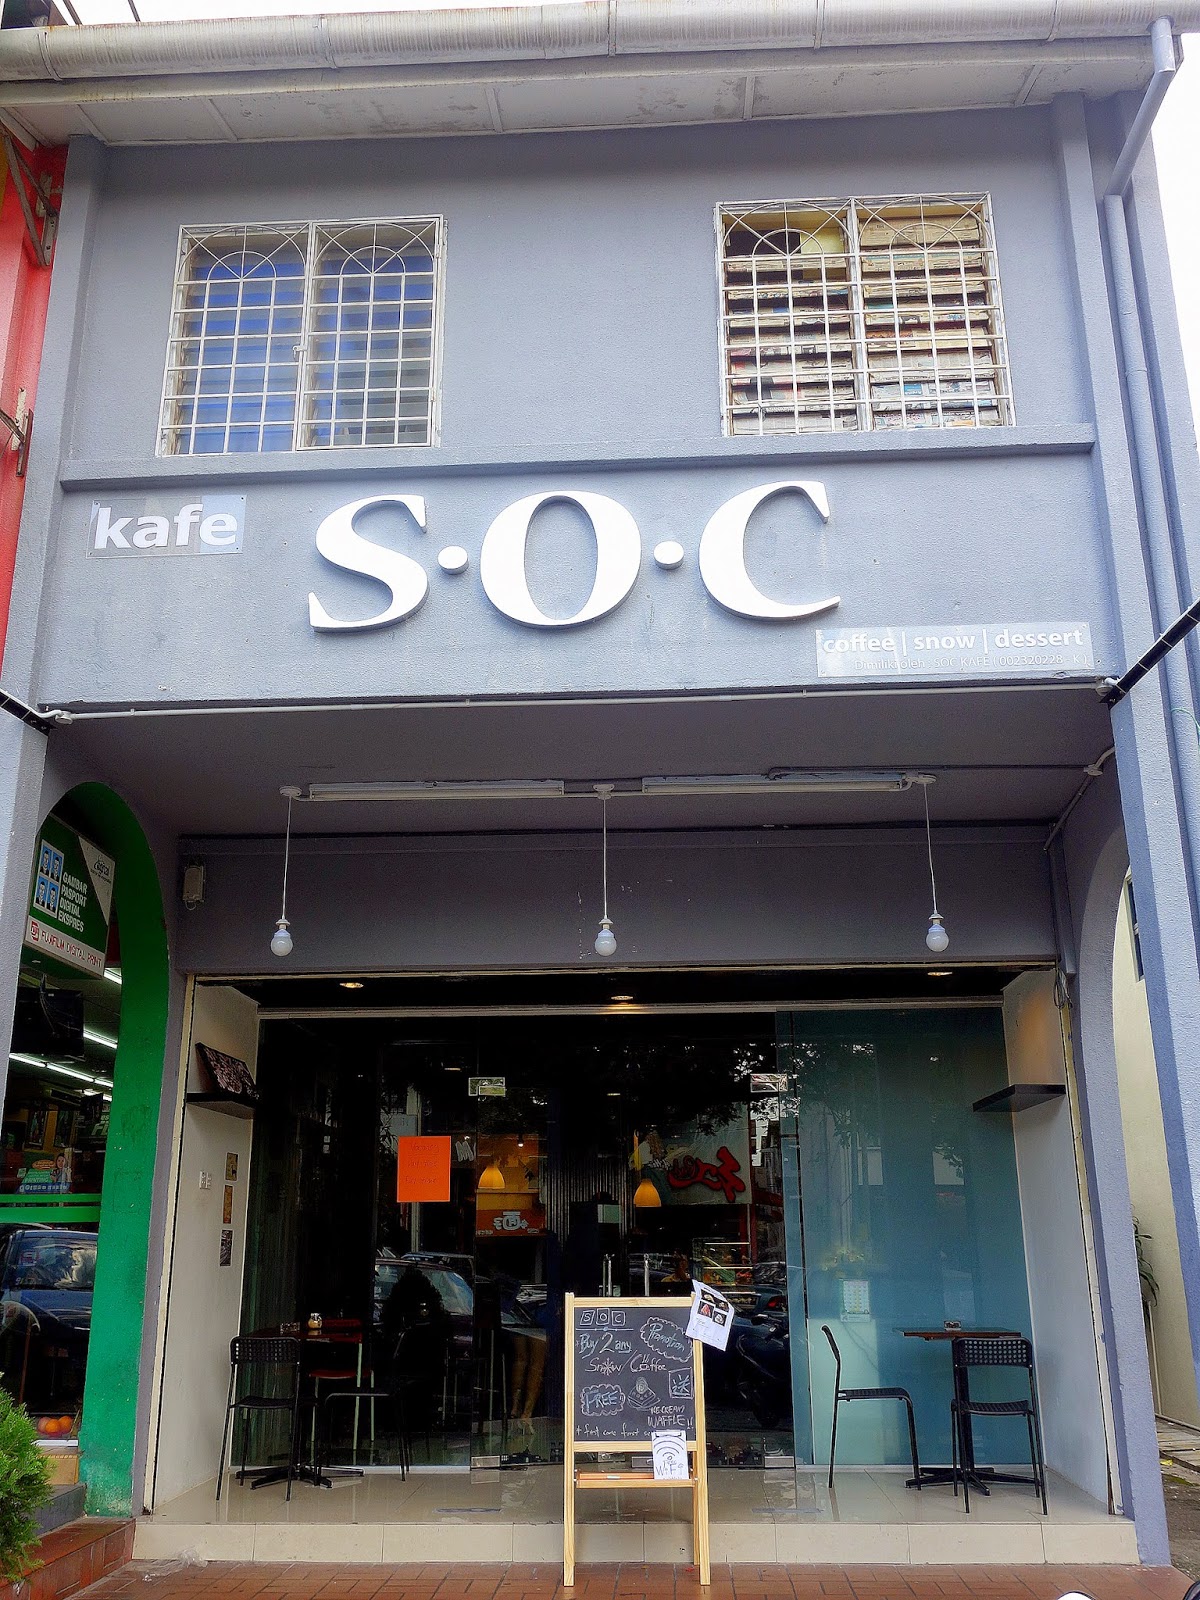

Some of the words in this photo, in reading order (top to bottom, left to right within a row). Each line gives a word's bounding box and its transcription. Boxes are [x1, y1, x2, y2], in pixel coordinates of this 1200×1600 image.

[94, 504, 238, 550] kafe
[823, 633, 897, 653] coffee
[914, 635, 976, 651] snow
[994, 628, 1084, 648] dessert
[935, 657, 957, 667] SOC
[960, 656, 991, 667] KAFE
[62, 871, 88, 895] GAMBAR
[60, 896, 81, 918] DIGITAL
[61, 884, 87, 908] PASPORT
[58, 909, 85, 933] EKSPRES
[579, 1333, 598, 1359] Buy
[599, 1332, 615, 1354] 2
[615, 1340, 633, 1353] any
[648, 1322, 686, 1352] Promotion
[672, 1374, 691, 1397] 送
[582, 1389, 619, 1414] FREE
